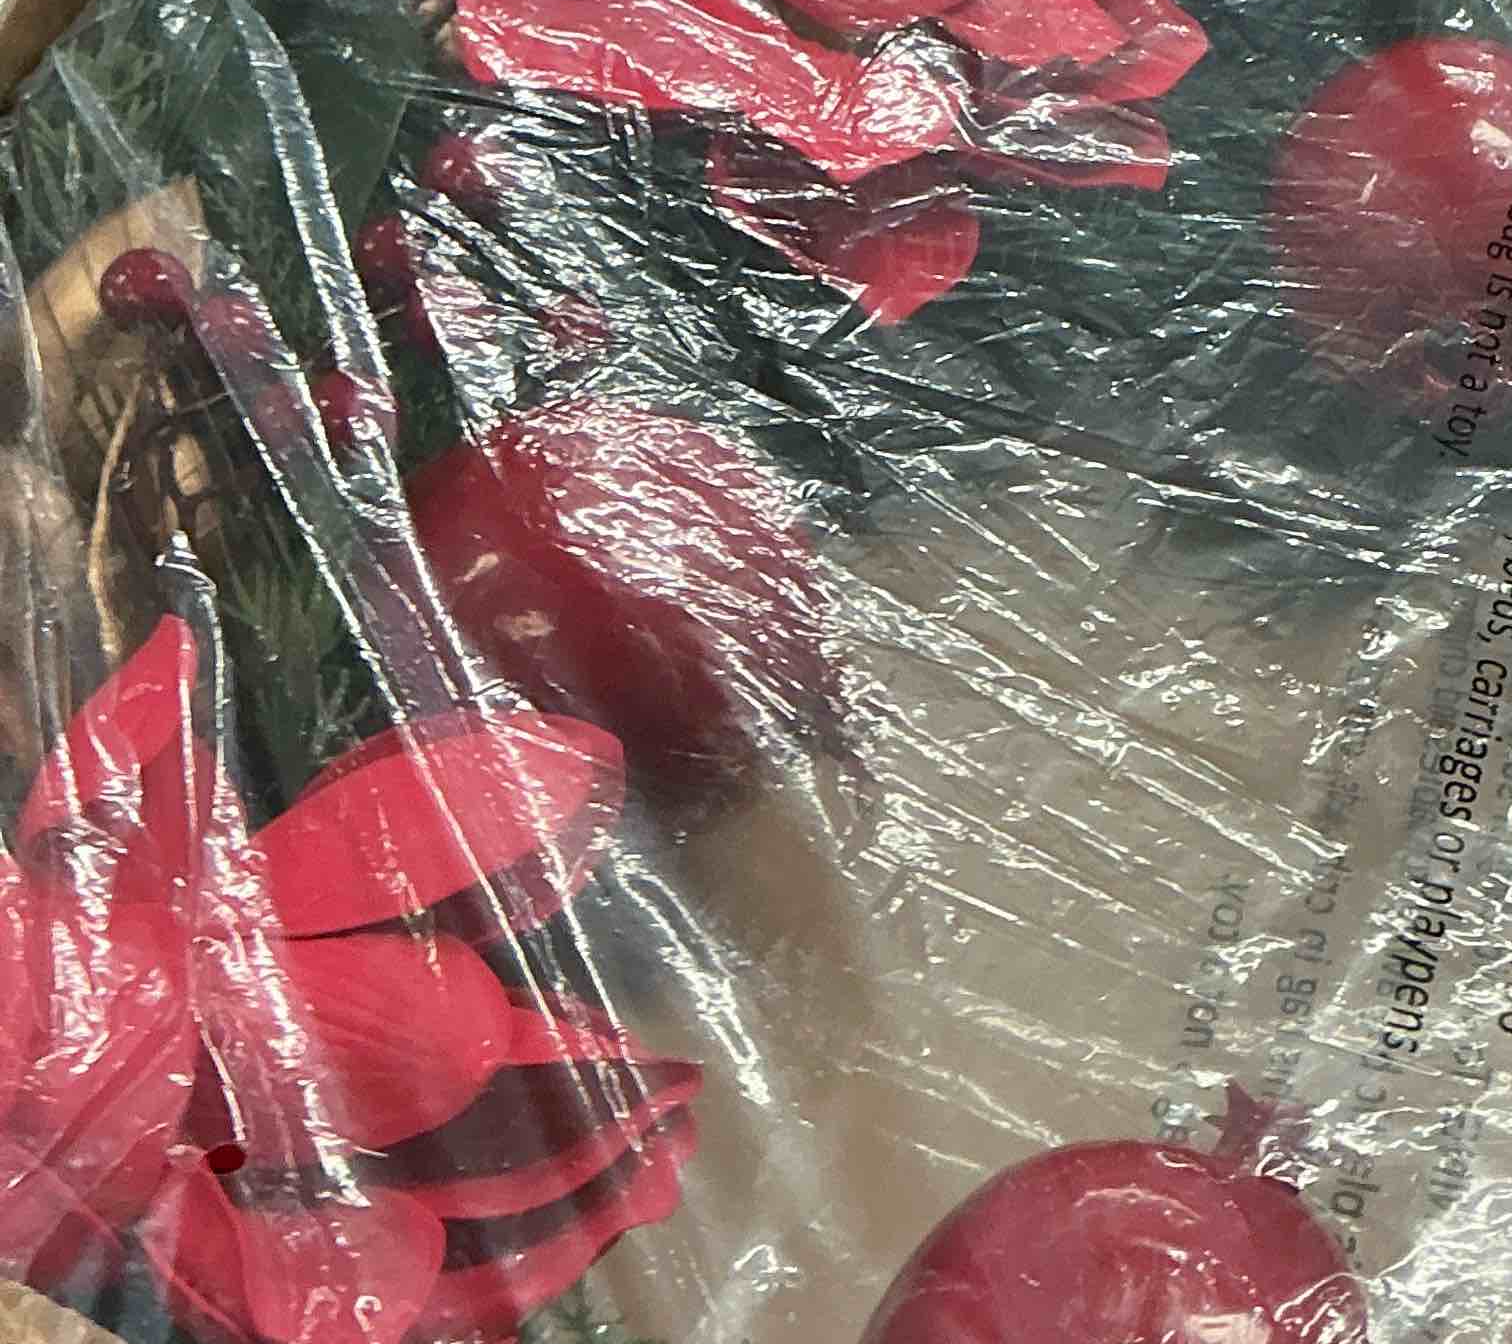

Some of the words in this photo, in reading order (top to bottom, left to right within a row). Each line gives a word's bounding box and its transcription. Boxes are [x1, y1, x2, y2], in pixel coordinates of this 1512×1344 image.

[1465, 308, 1508, 369] not
[1457, 373, 1489, 394] a
[1431, 404, 1485, 459] toy.
[1437, 658, 1508, 822] carriages
[1424, 832, 1466, 874] or
